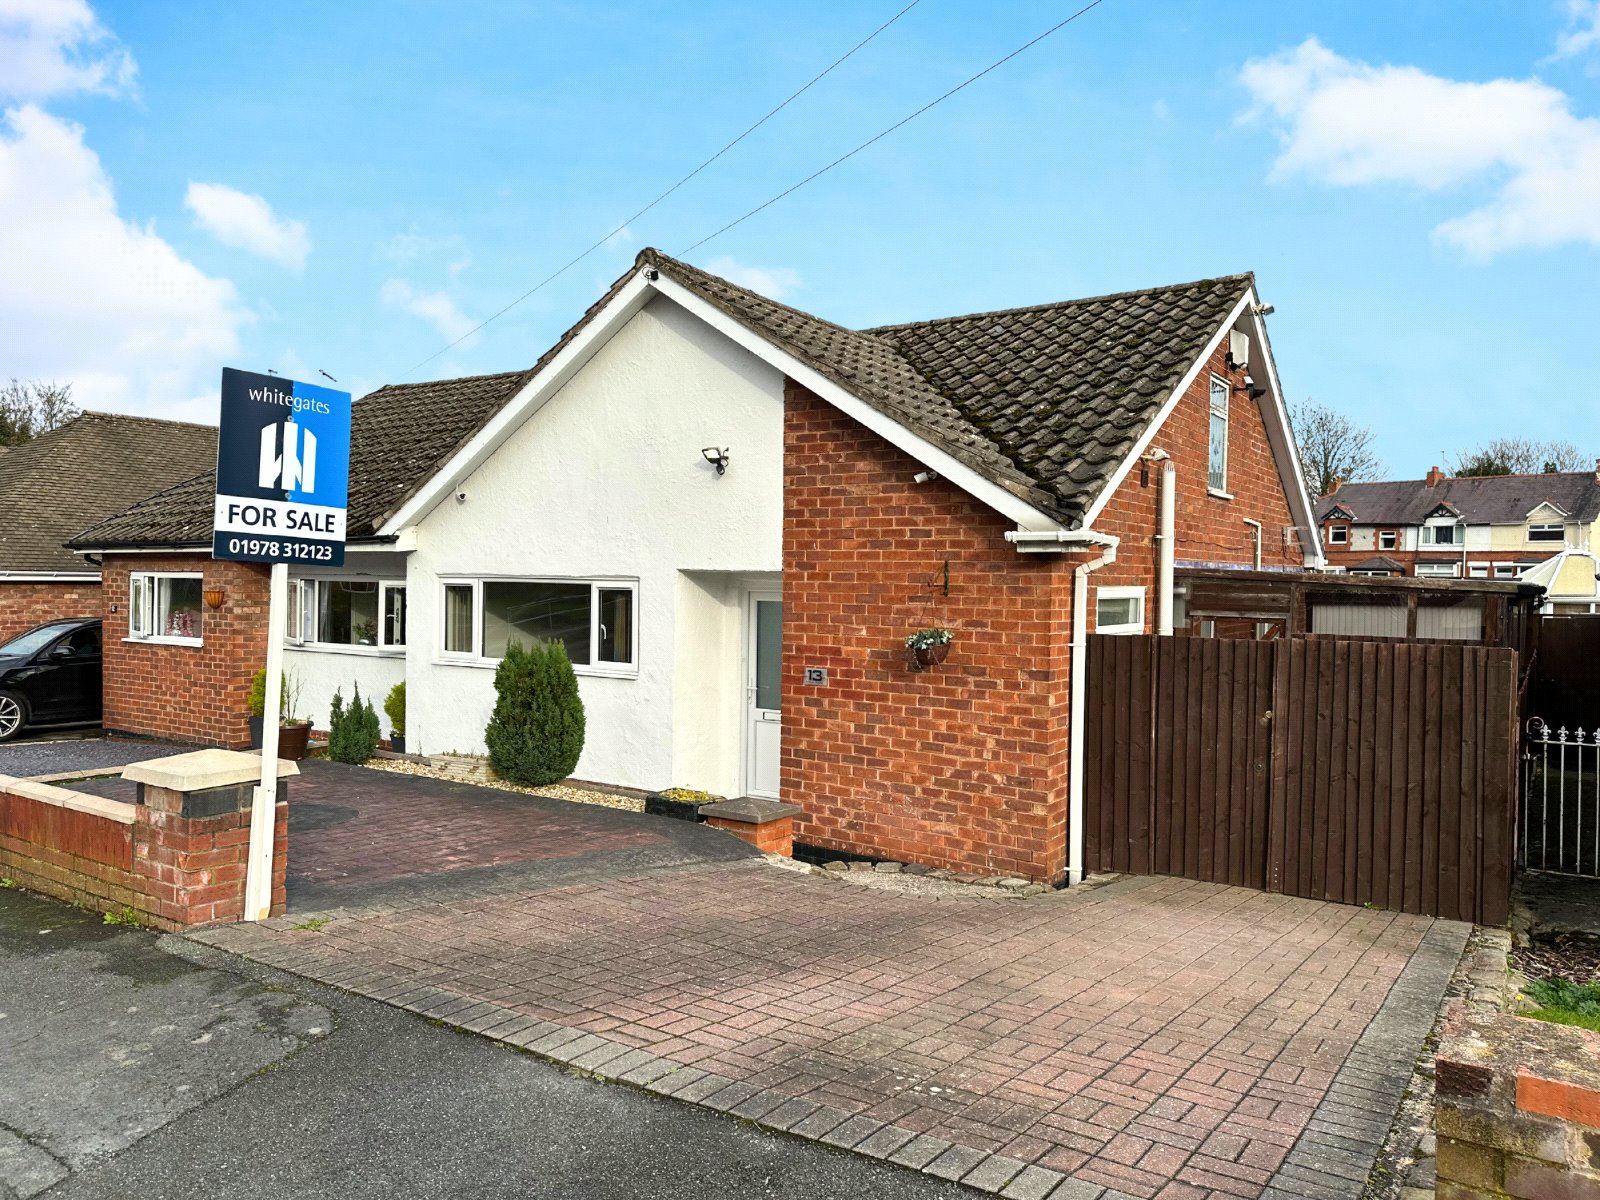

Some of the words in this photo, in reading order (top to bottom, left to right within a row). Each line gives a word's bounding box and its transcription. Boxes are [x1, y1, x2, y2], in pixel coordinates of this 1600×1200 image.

[249, 386, 330, 414] whitegates
[228, 503, 277, 528] FOR
[286, 509, 335, 533] SALE
[229, 538, 280, 557] 01978
[282, 542, 332, 560] 312123
[807, 669, 822, 681] 13
